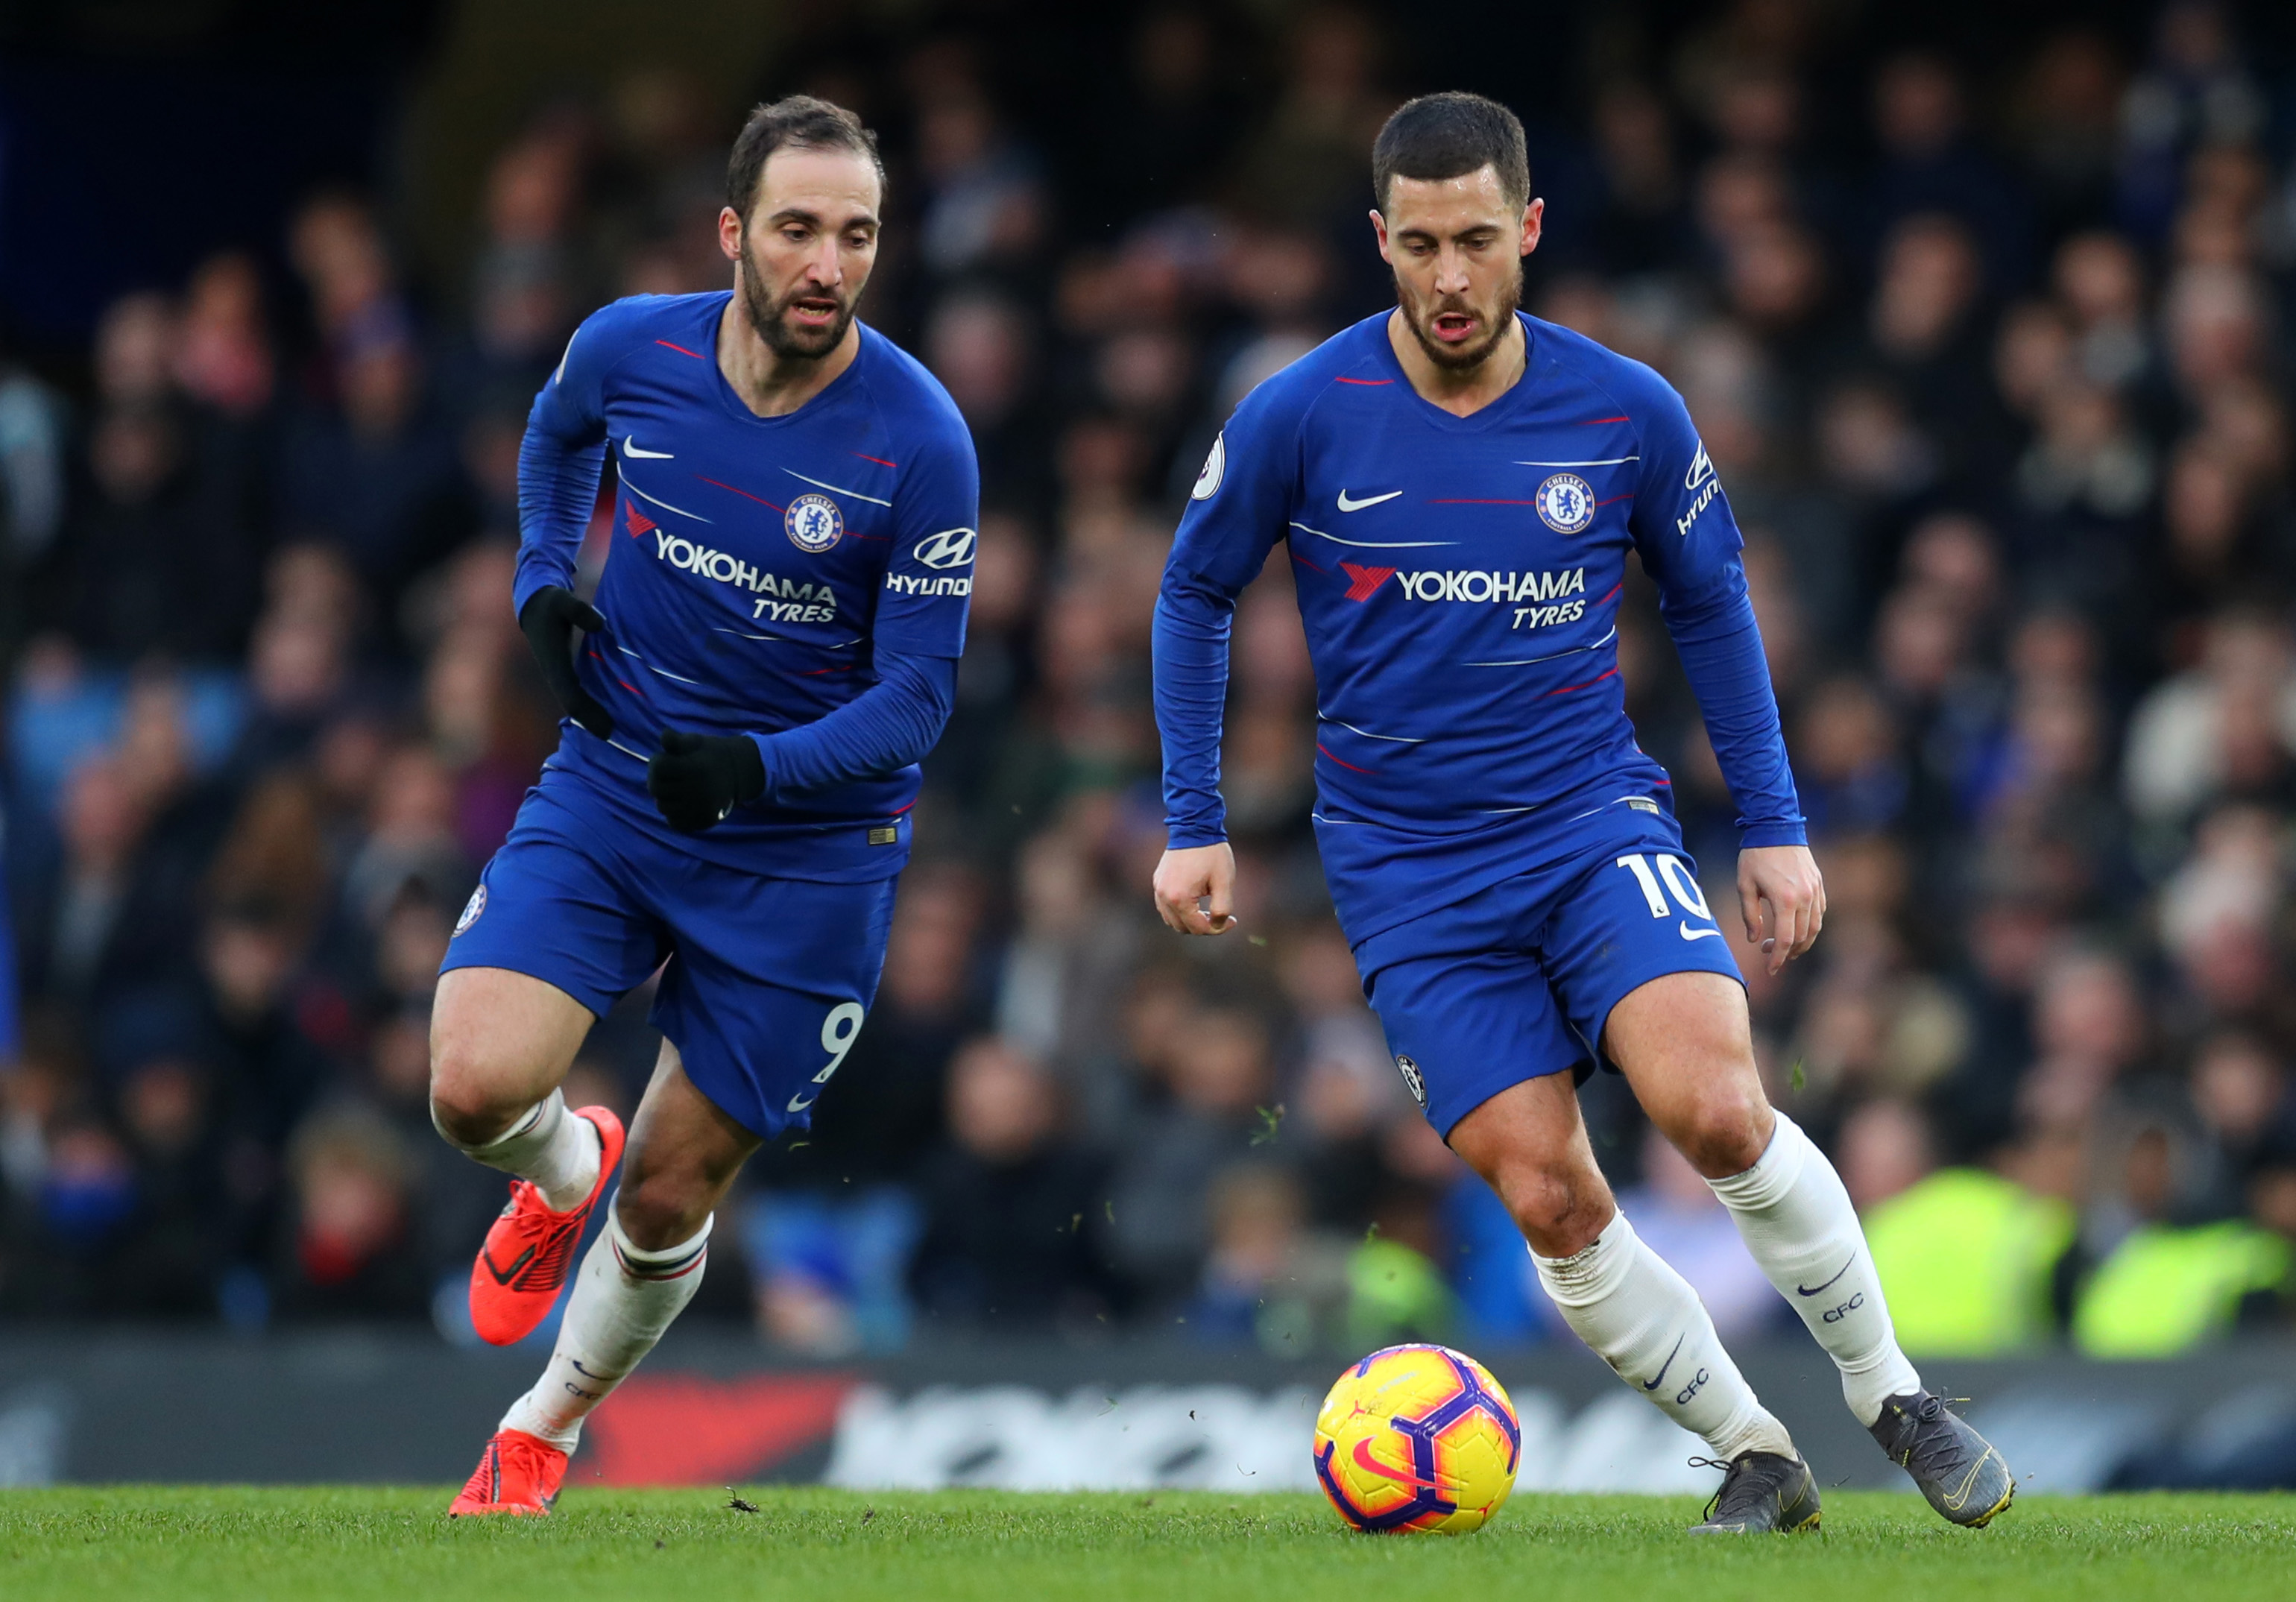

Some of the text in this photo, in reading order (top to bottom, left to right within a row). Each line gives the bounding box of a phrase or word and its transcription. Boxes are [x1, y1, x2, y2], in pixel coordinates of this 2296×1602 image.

[1546, 476, 1584, 491] CHELSEA
[801, 496, 836, 515] CHELSEA
[1677, 478, 1721, 535] HYUN
[655, 528, 837, 607] YOKOHAMA
[1395, 567, 1586, 604] YOKOHAMA
[751, 598, 836, 622] TYRES
[1511, 599, 1586, 630] TYRES
[1615, 853, 1712, 921] 10
[811, 1002, 865, 1083] 9
[1823, 1292, 1864, 1323] CFC
[1677, 1367, 1709, 1405] CFC
